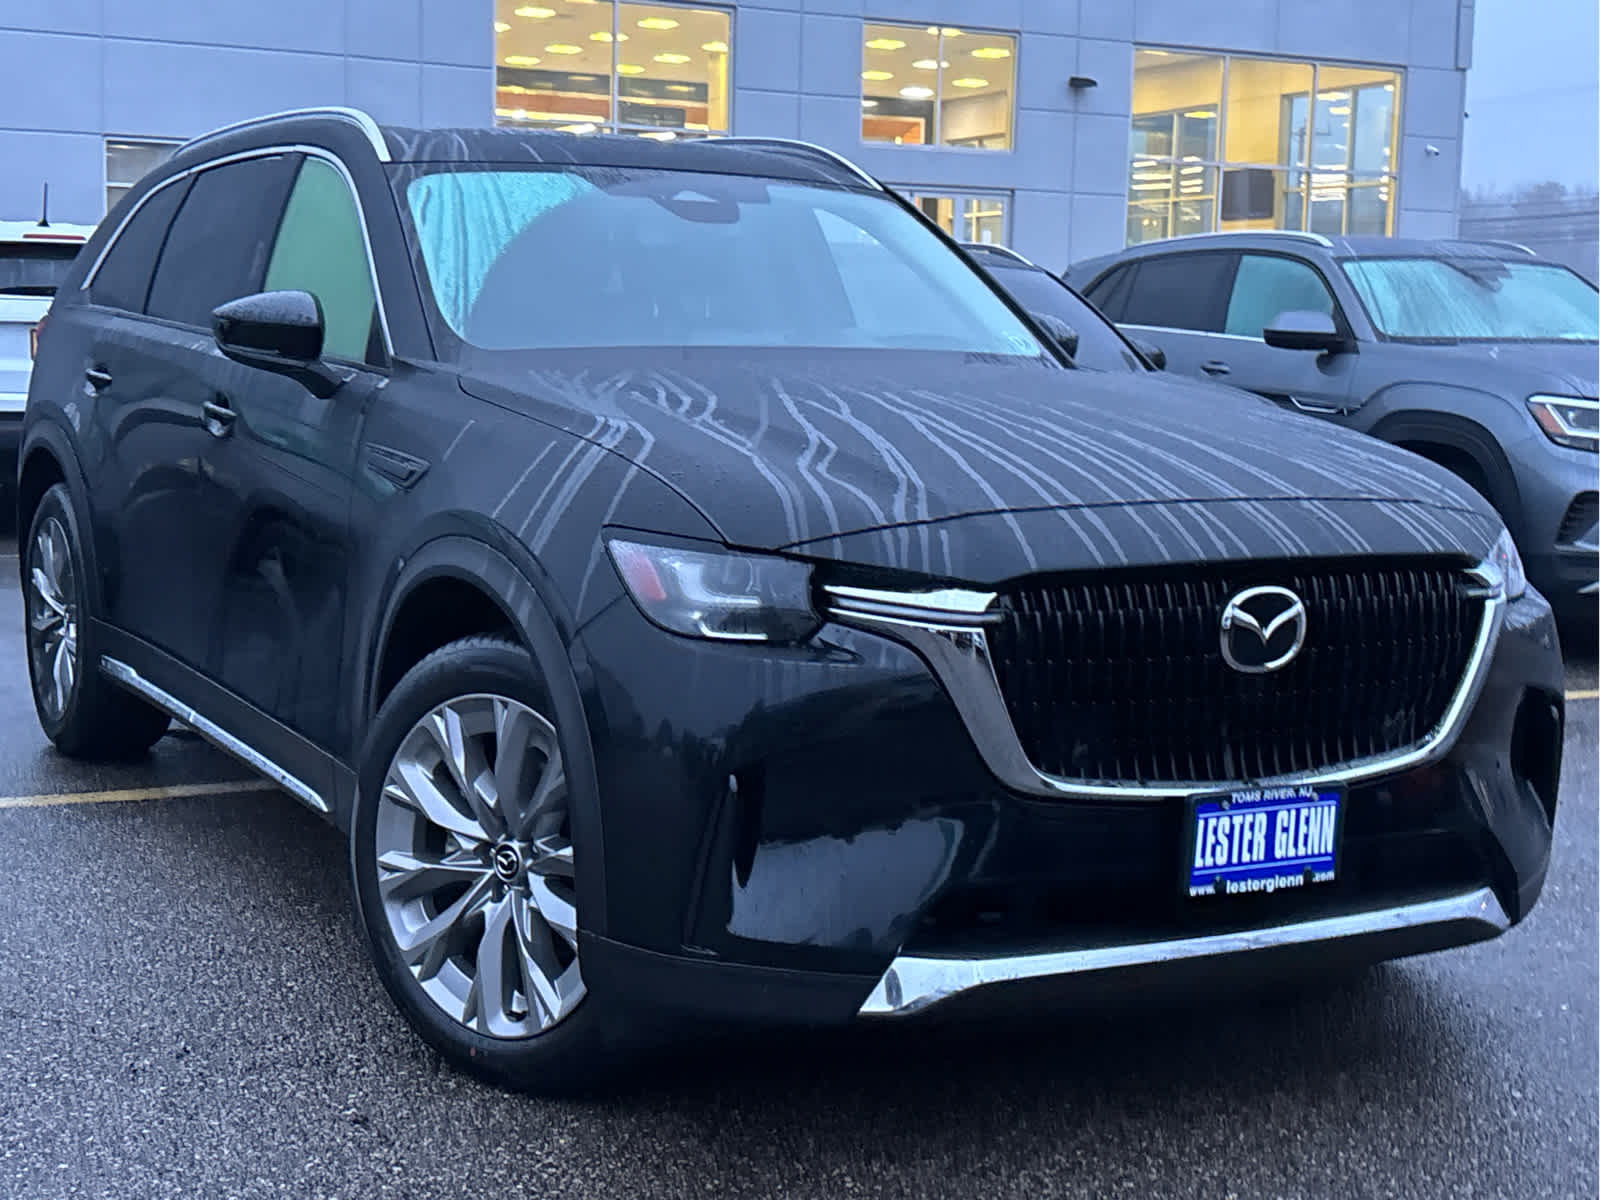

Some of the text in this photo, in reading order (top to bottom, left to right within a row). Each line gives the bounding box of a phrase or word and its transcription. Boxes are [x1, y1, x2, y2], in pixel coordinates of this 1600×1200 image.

[1231, 790, 1261, 804] TOMS
[1194, 805, 1337, 868] LESTER GLENN
